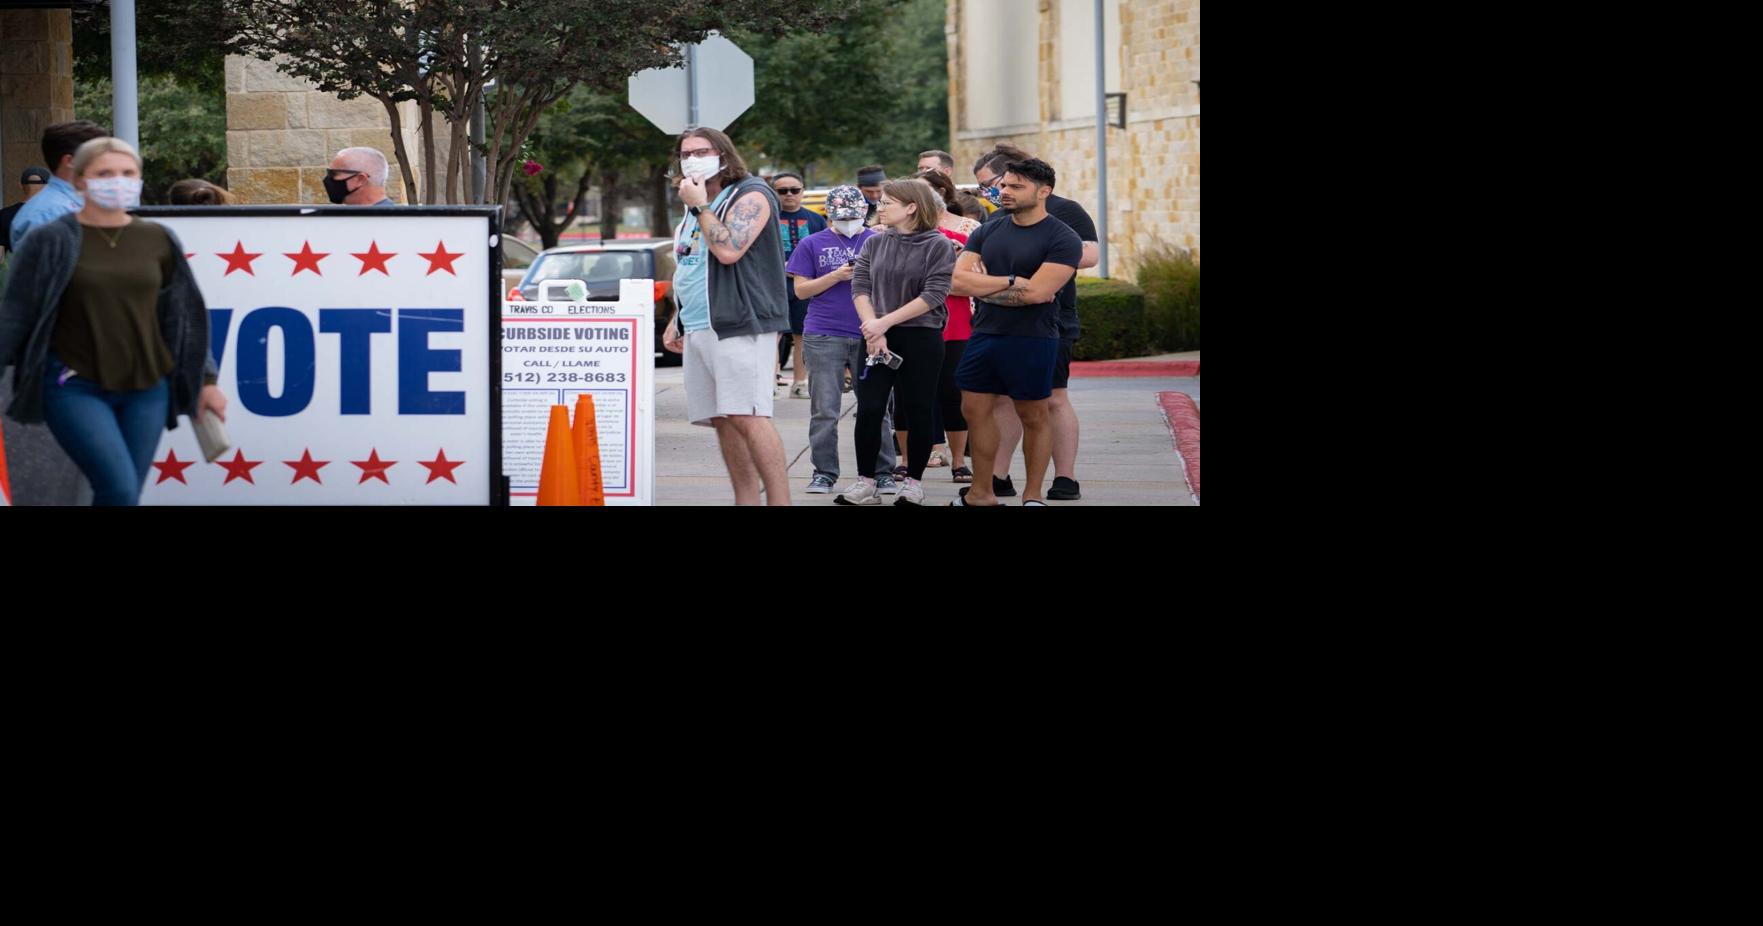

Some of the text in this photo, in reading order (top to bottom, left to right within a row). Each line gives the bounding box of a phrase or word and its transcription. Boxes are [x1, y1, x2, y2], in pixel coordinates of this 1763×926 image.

[510, 305, 616, 315] TRAVIS CO ELECTIONS
[574, 327, 630, 340] VOTING
[503, 345, 629, 353] OTAR DESDE SU AUTO
[206, 306, 466, 417] OTE
[523, 360, 552, 368] CALL
[562, 360, 601, 368] LLAME
[503, 372, 627, 384] 512) 238-8683
